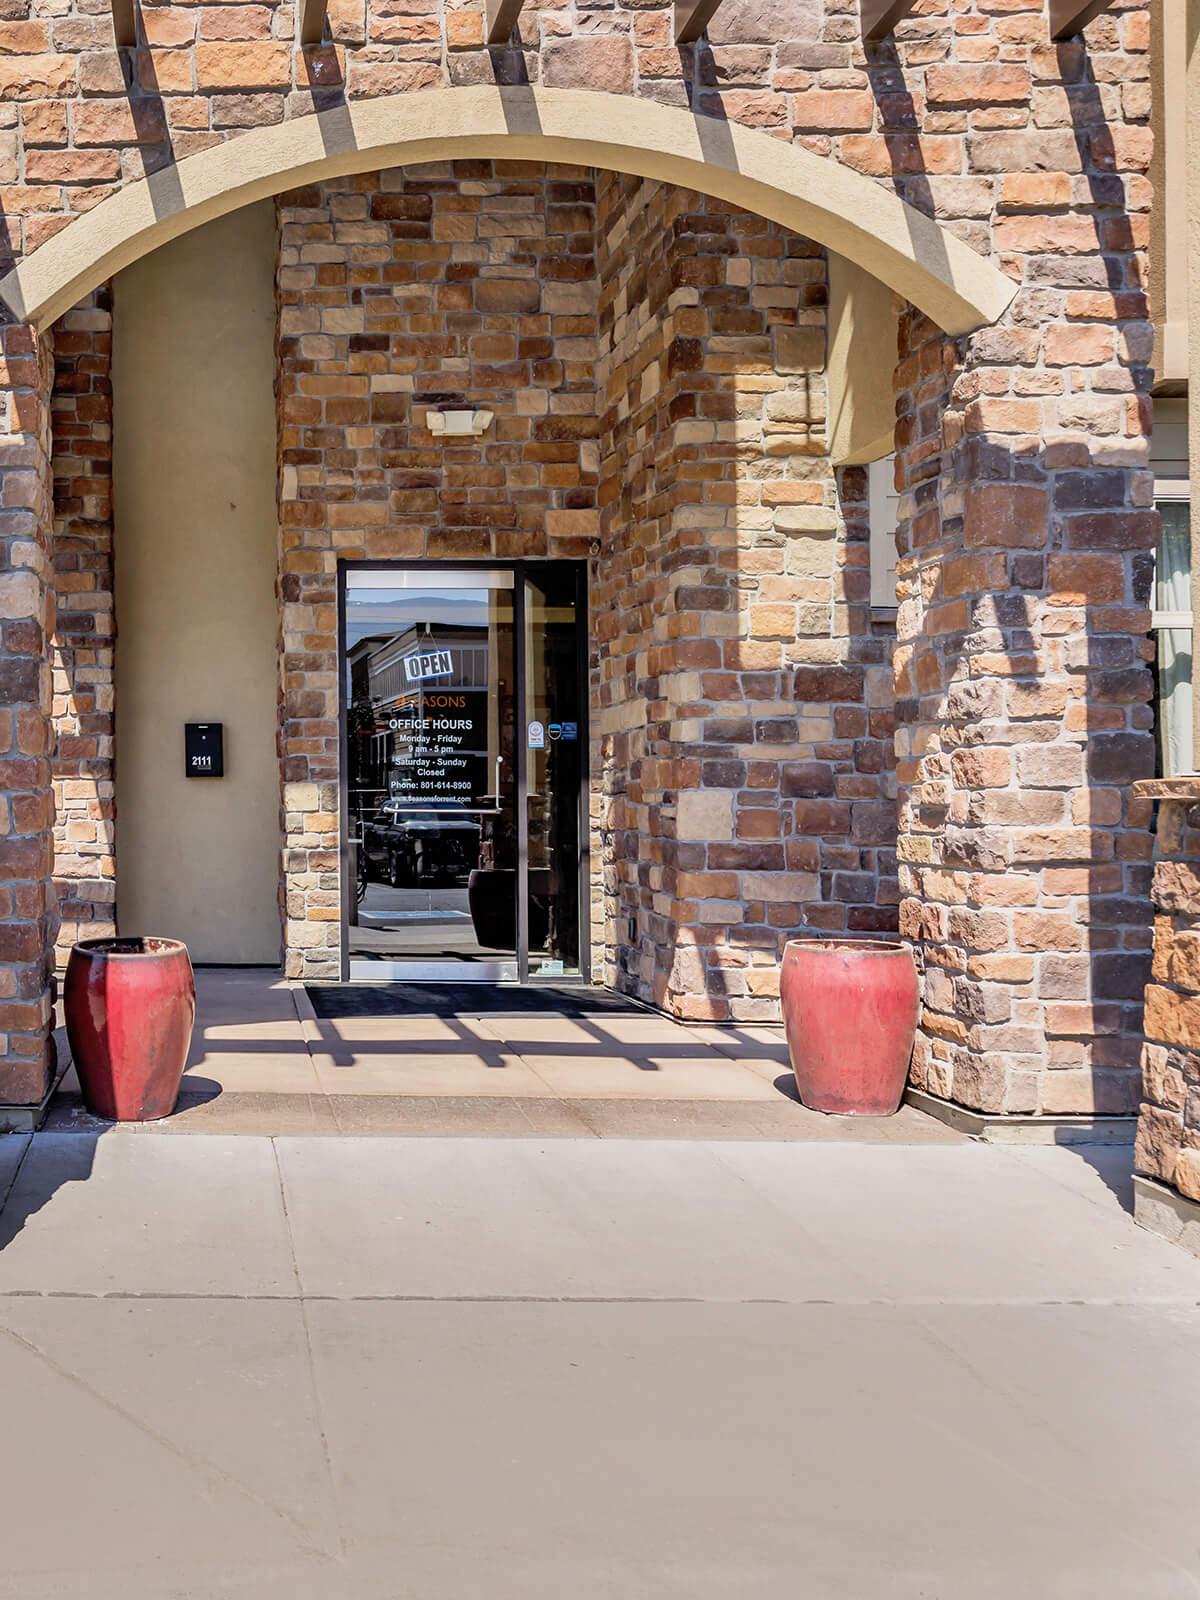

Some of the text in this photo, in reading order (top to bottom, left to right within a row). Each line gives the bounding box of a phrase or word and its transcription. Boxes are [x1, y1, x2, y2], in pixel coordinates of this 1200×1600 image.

[409, 653, 450, 677] OPEN
[412, 695, 466, 708] ASONS
[389, 719, 473, 729] OFFICE HOURS
[399, 734, 430, 744] Monday
[437, 734, 462, 744] Friday
[441, 746, 454, 754] pm
[191, 755, 212, 766] 2111
[395, 758, 430, 767] Saturday
[437, 758, 467, 767] Sunday
[417, 768, 445, 776] Closed
[391, 781, 472, 789] Phone: 801-614-8900
